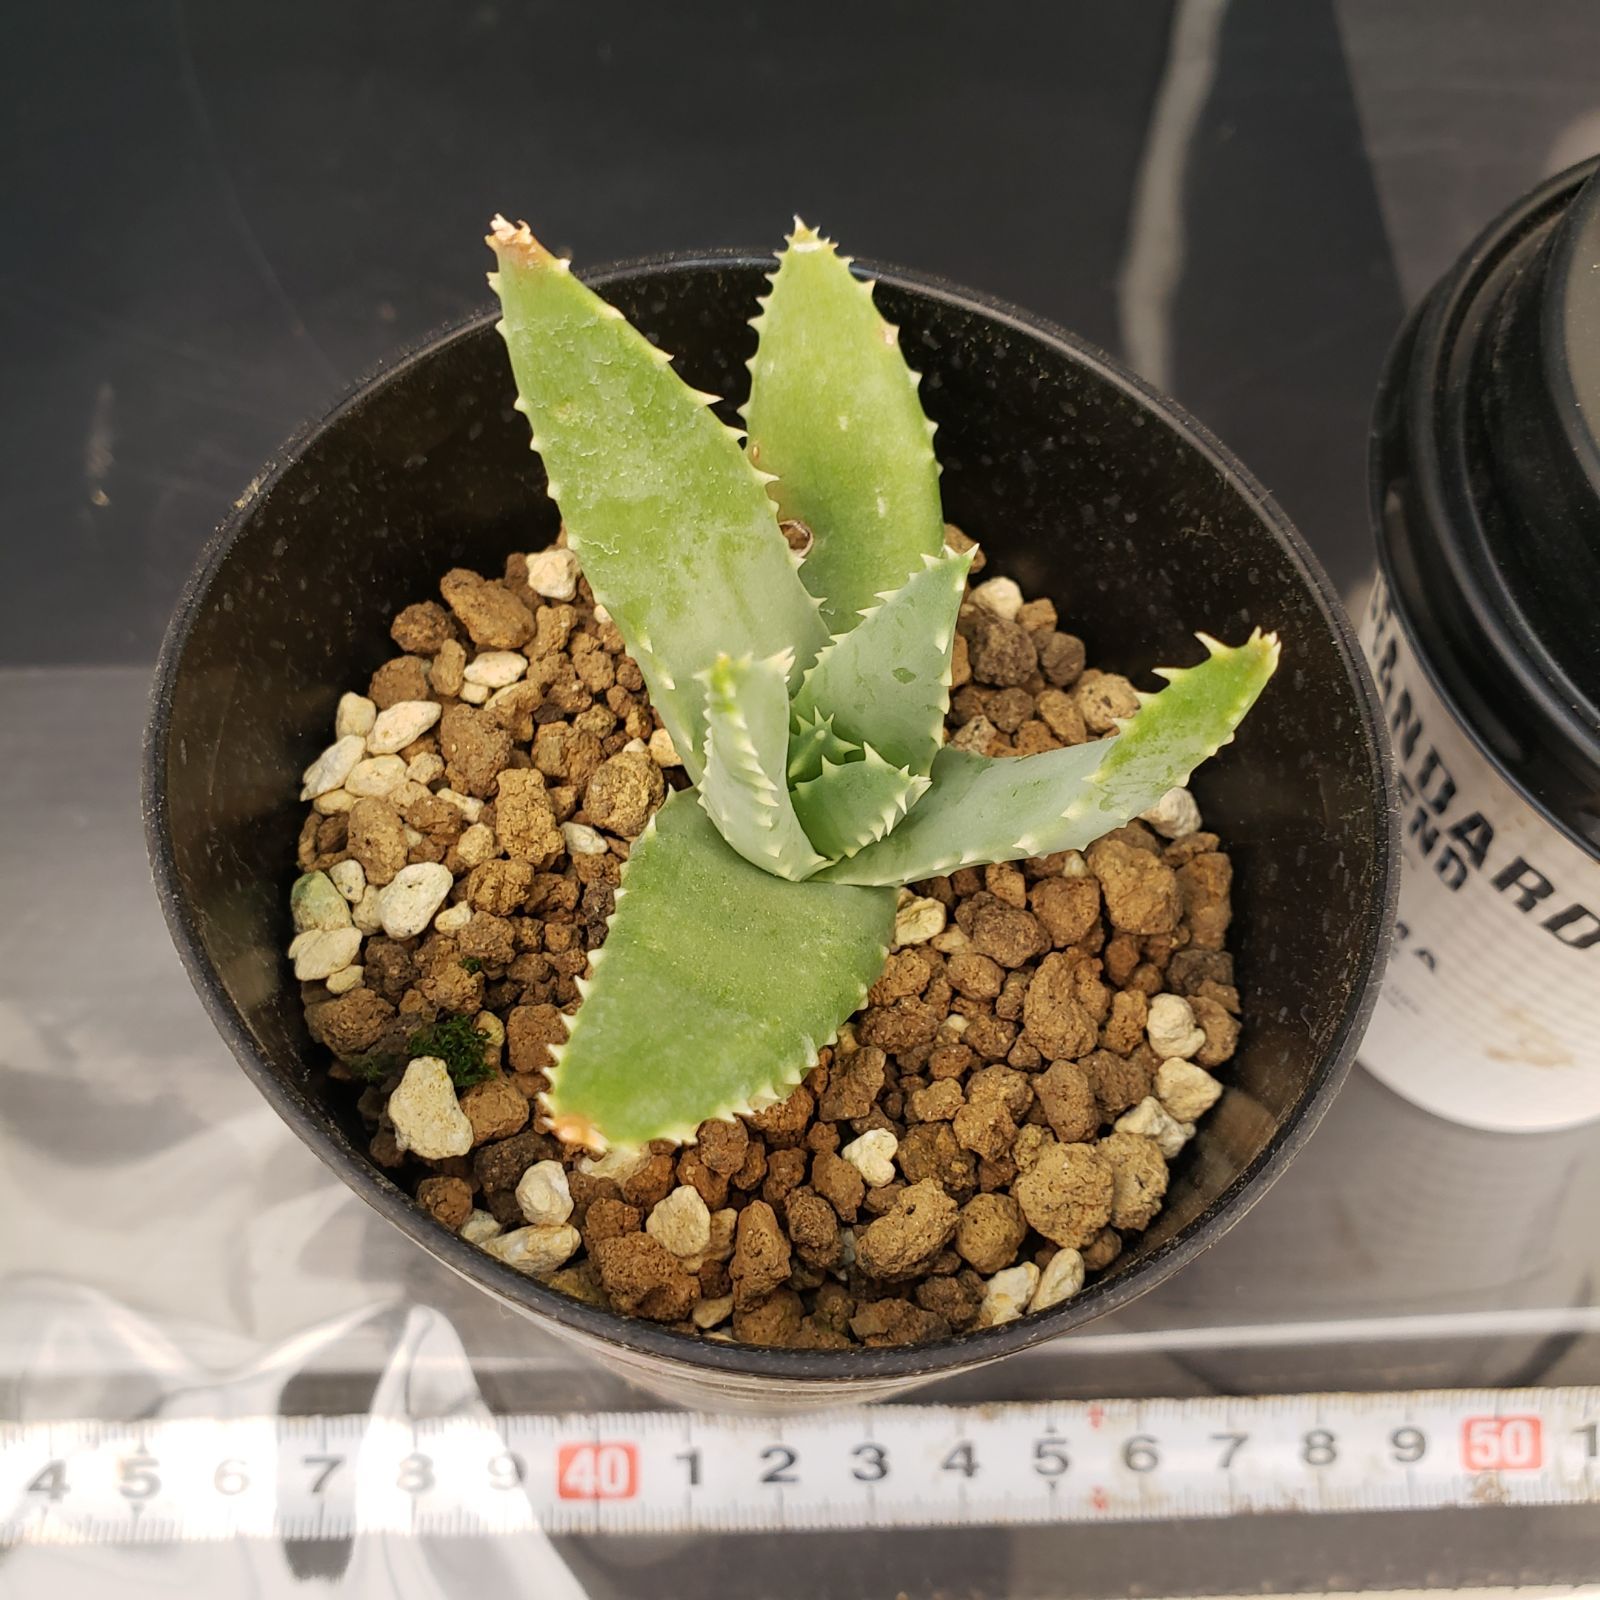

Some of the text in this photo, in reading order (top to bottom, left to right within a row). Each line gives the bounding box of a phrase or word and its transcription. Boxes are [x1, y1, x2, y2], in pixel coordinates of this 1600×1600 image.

[27, 1419, 1598, 1502] 4 5 6 7 8 9 40 1 2 3 4 5 6 7 8 9 50 1
